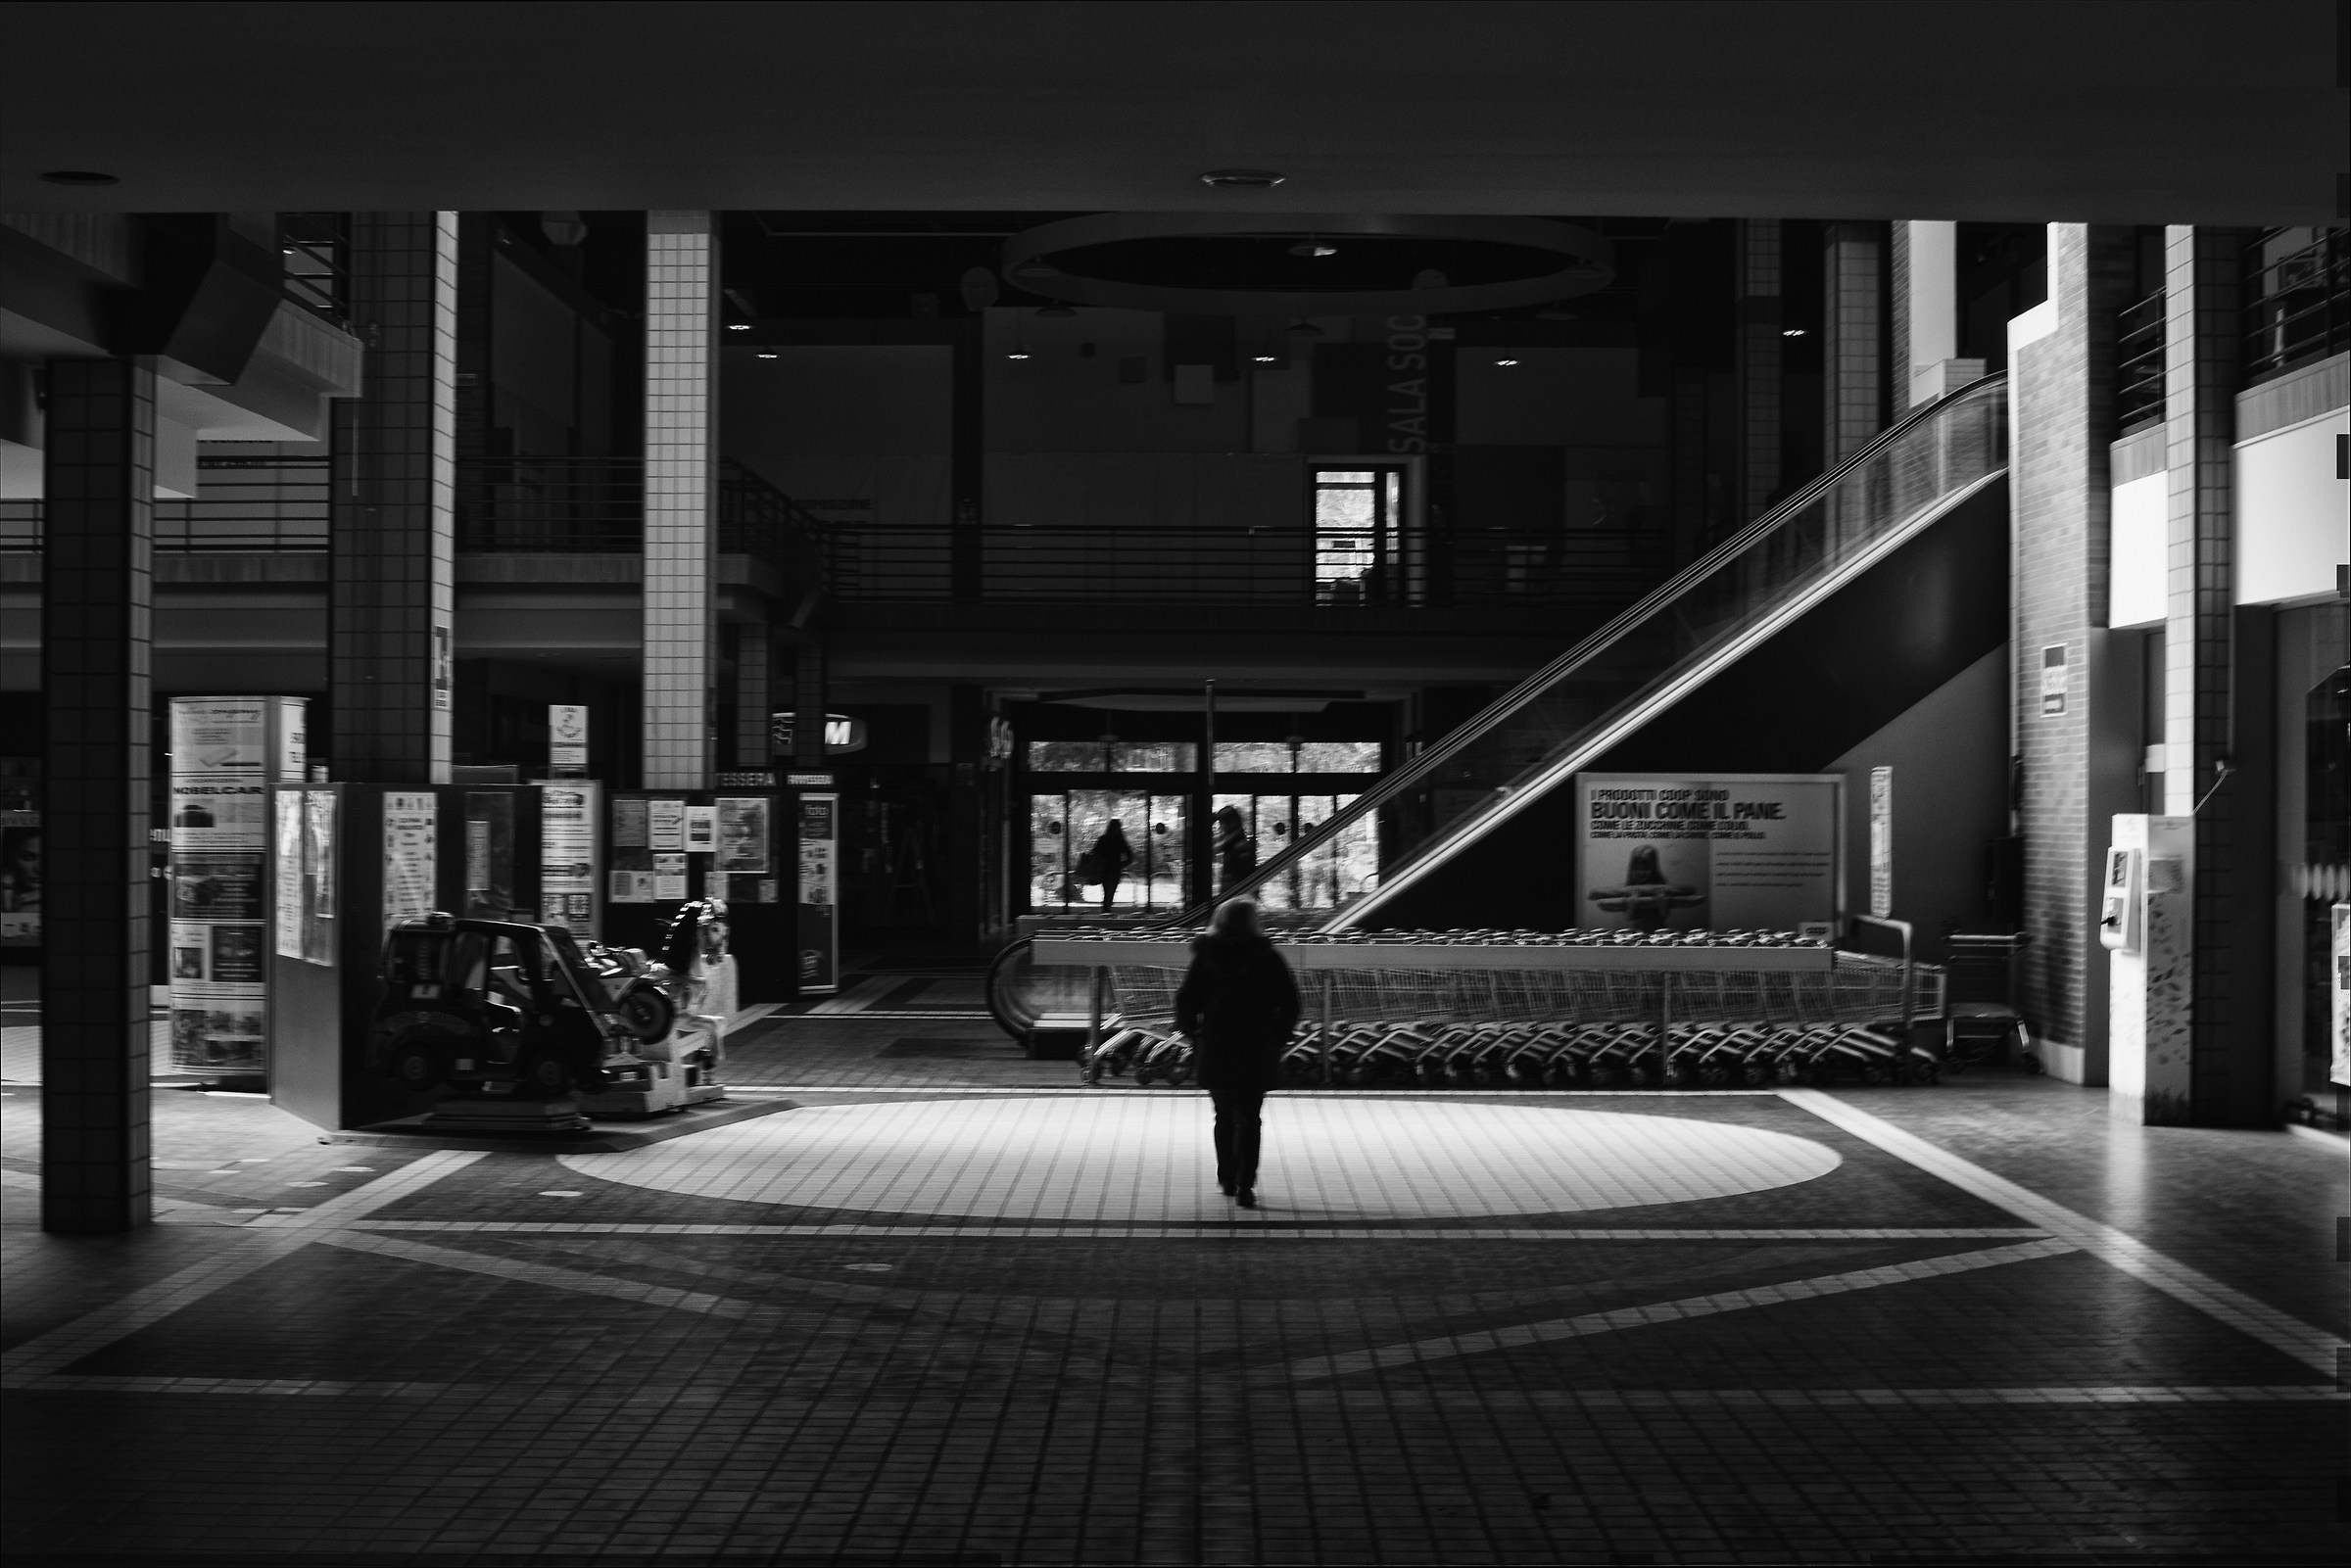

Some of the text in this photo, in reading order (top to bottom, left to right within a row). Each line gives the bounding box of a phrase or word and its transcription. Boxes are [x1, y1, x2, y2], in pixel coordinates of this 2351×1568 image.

[1386, 379, 1425, 452] SALA
[1598, 789, 1657, 801] PRODOTTI
[1658, 789, 1693, 801] COOP
[1694, 789, 1730, 801] SONO
[1591, 802, 1787, 820] BUONI COME IL PANE.
[1590, 821, 1620, 832] COME
[1621, 821, 1635, 832] LE
[1687, 821, 1717, 832] COME
